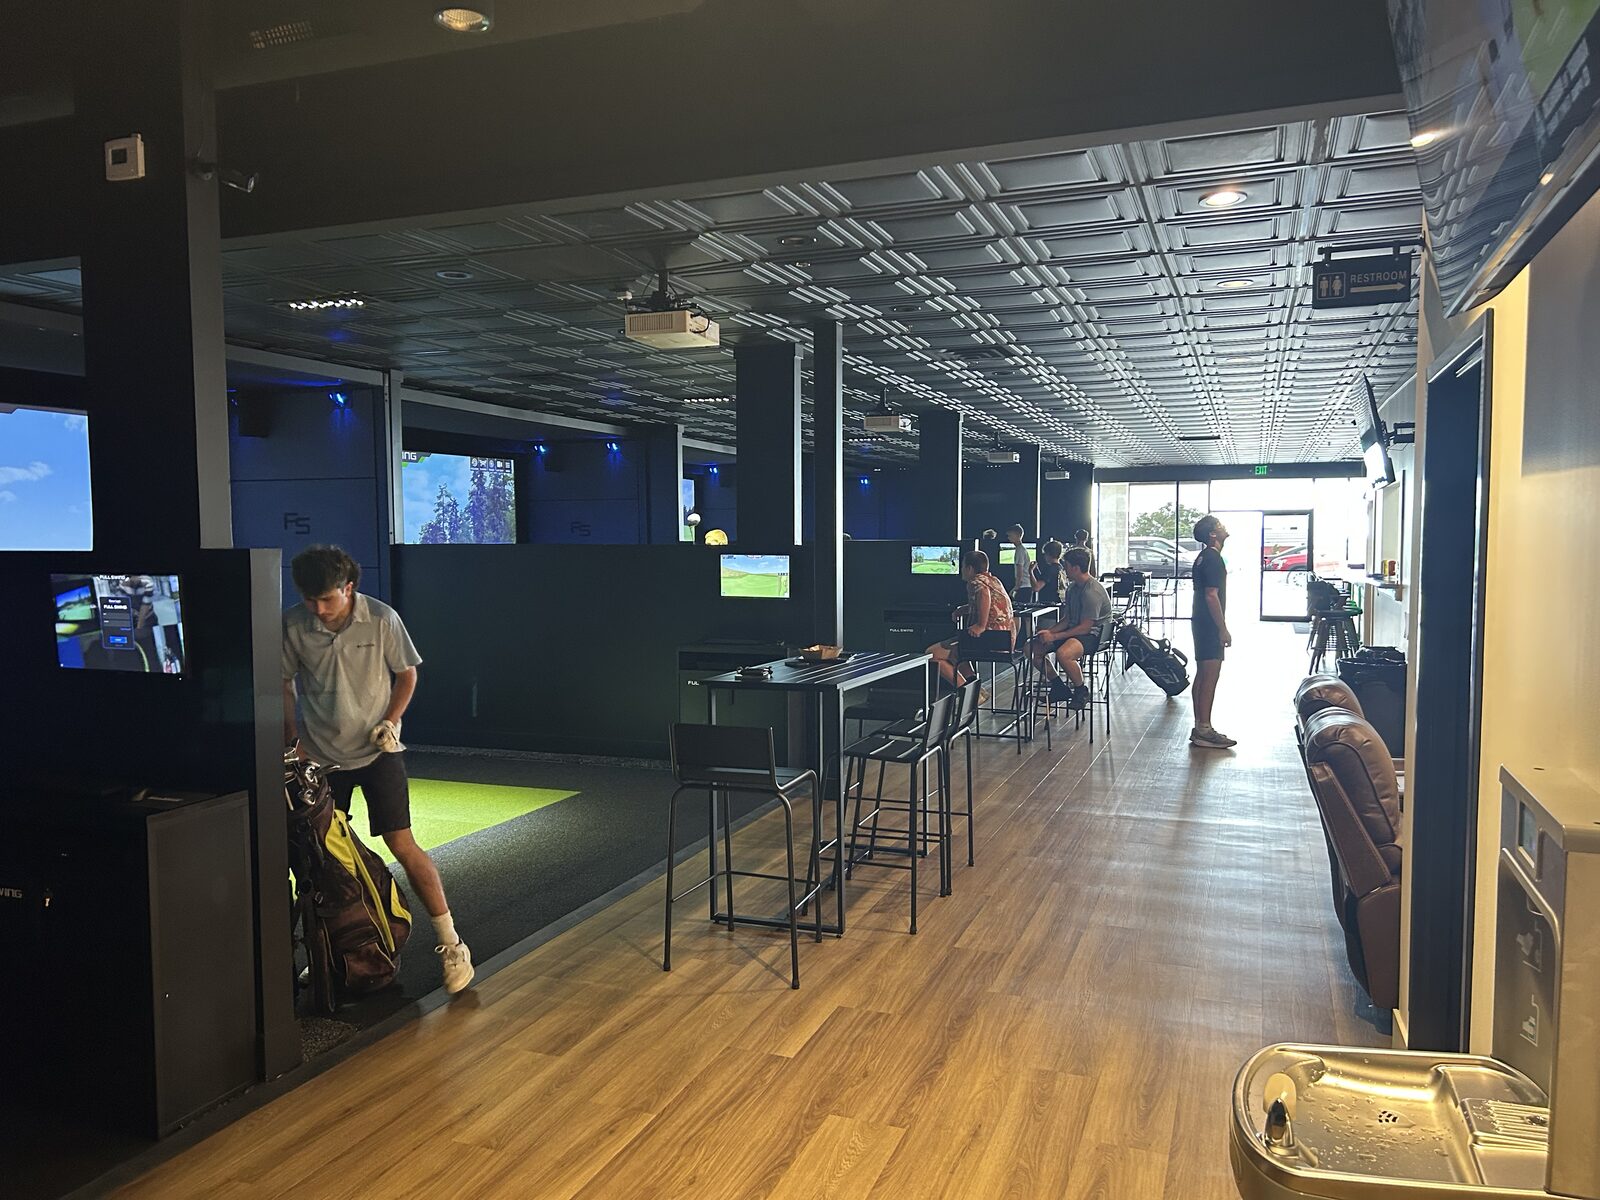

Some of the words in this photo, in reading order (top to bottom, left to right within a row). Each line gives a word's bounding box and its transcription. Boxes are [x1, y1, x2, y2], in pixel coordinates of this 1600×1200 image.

[1350, 270, 1407, 283] RESTROOM
[401, 451, 417, 460] ING
[1255, 465, 1268, 475] EXIT
